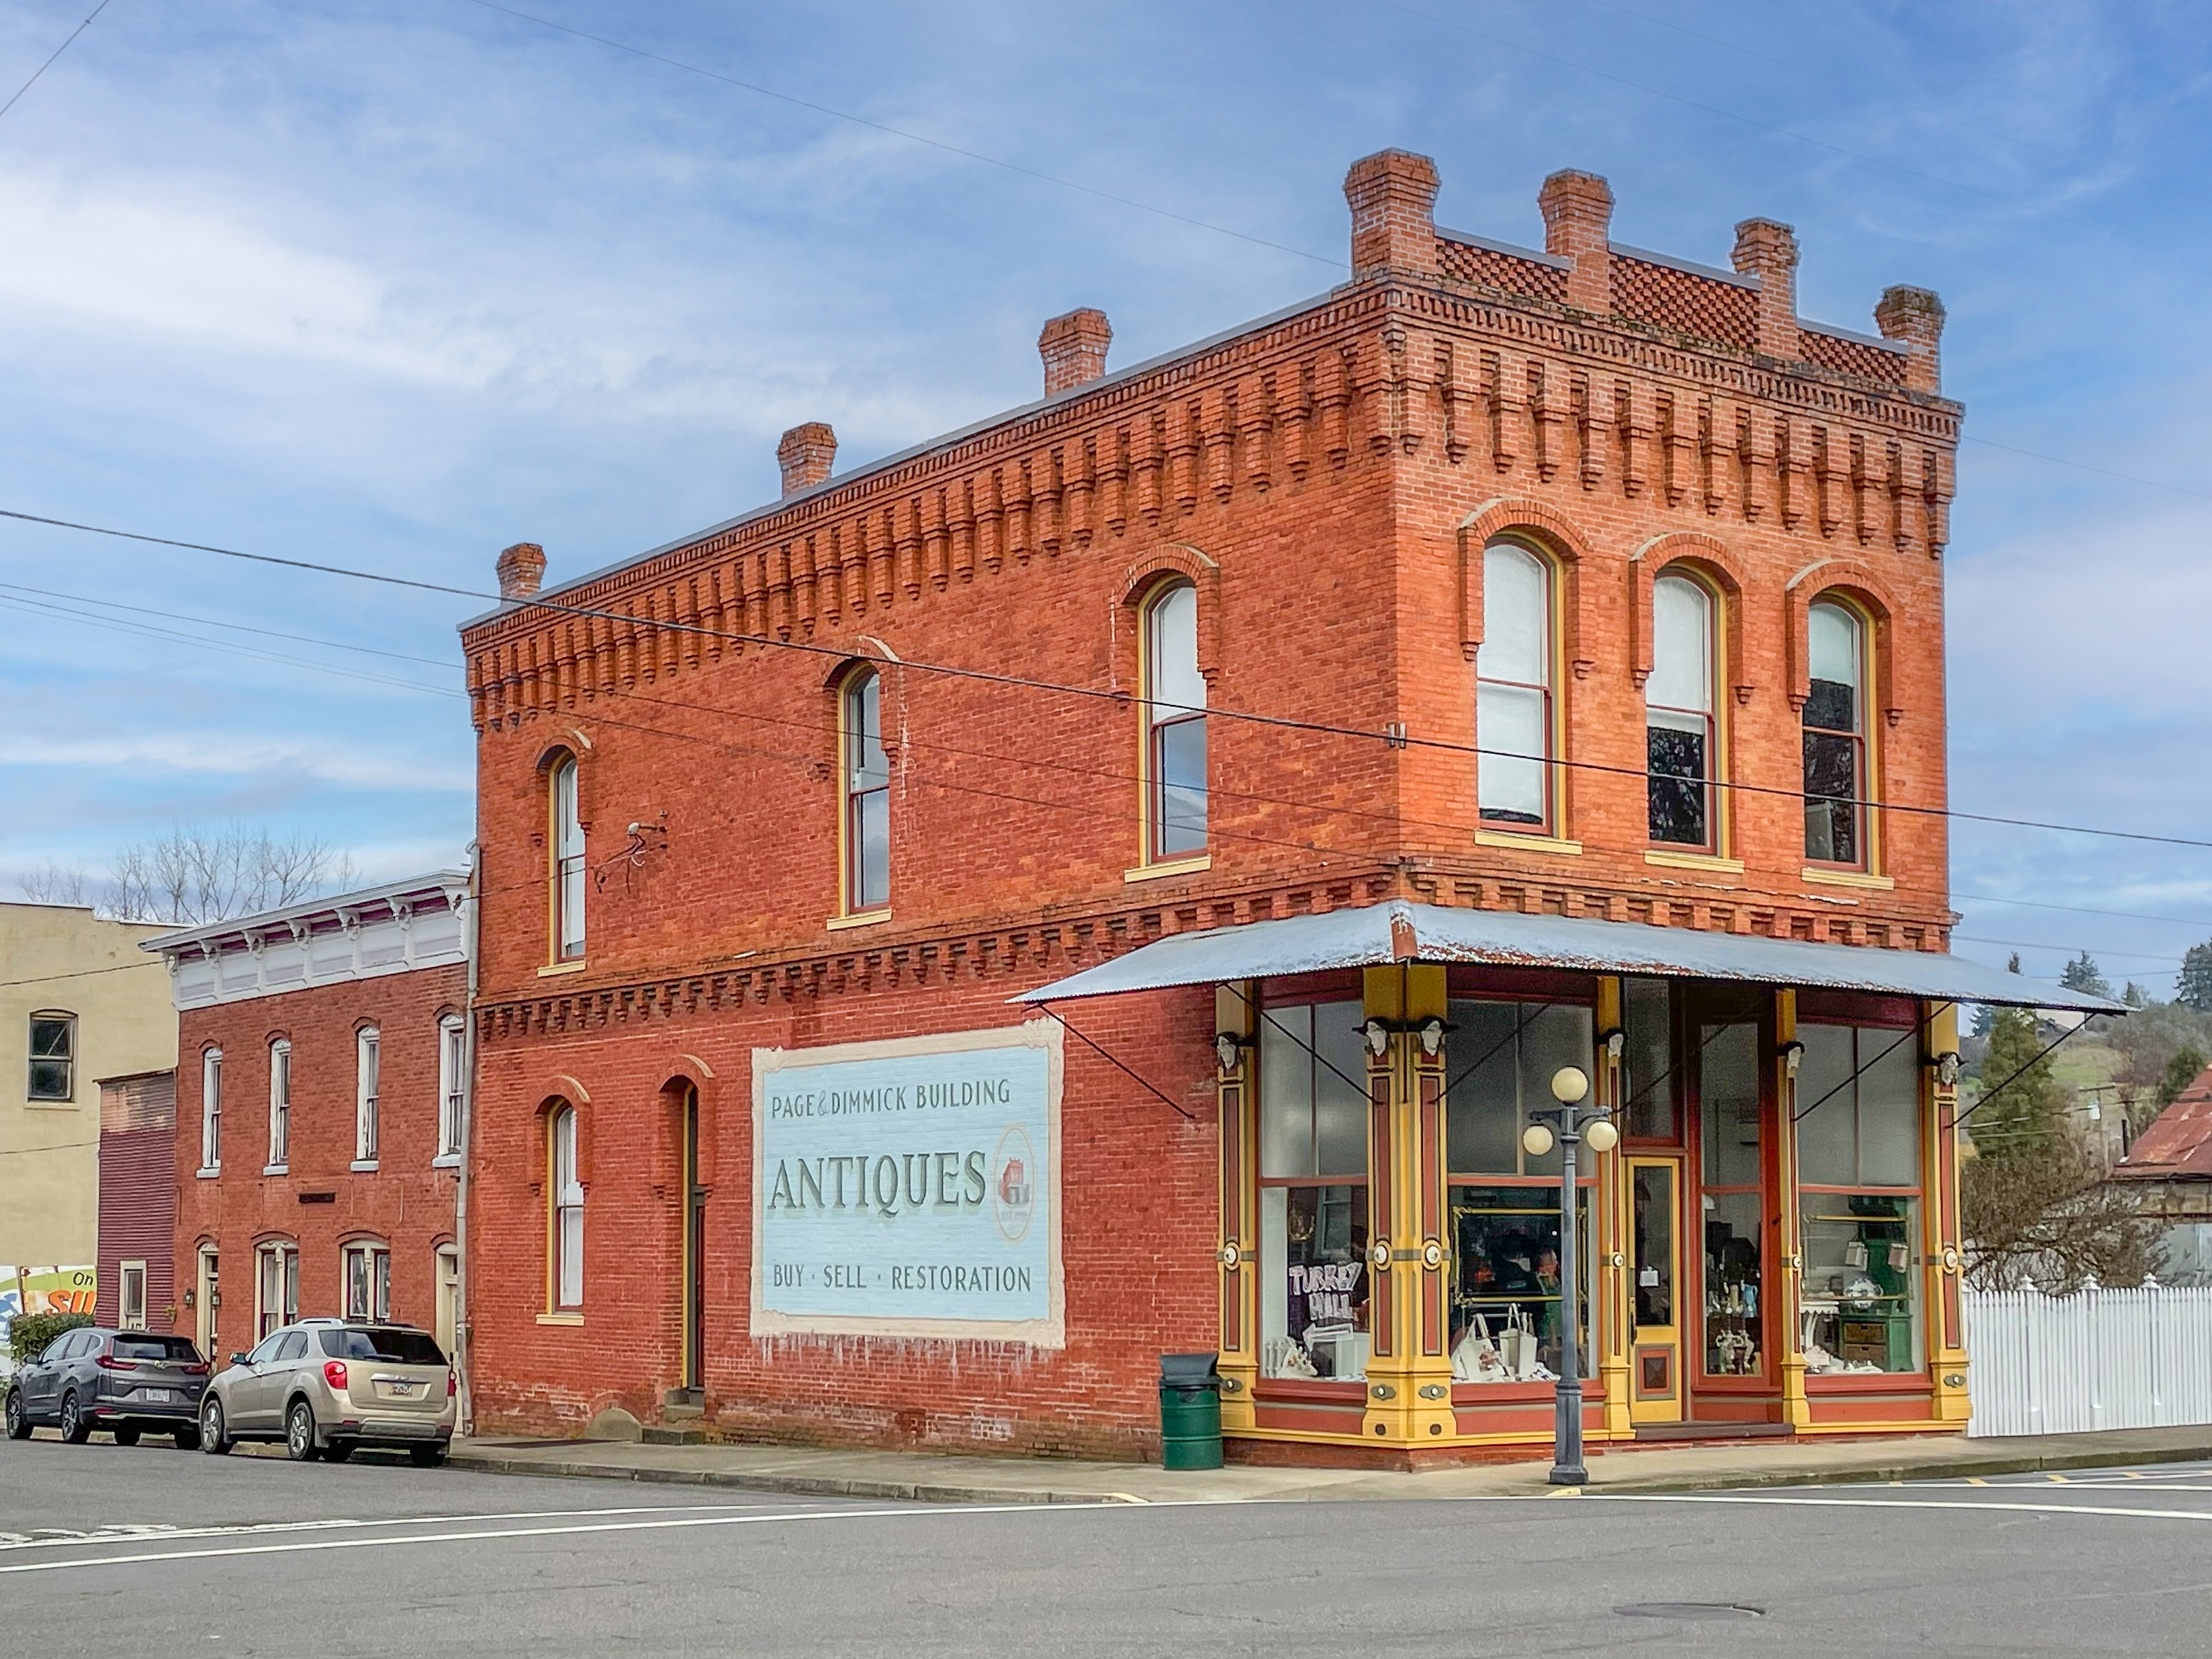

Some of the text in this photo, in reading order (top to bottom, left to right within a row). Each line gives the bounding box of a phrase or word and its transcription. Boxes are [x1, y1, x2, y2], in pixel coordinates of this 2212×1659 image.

[916, 1078, 1010, 1109] BUILDING
[767, 1150, 986, 1218] ANTIQUES
[73, 1271, 94, 1286] On
[773, 1264, 1031, 1292] BUY SELL RESTORATION
[1308, 1292, 1354, 1321] HILL
